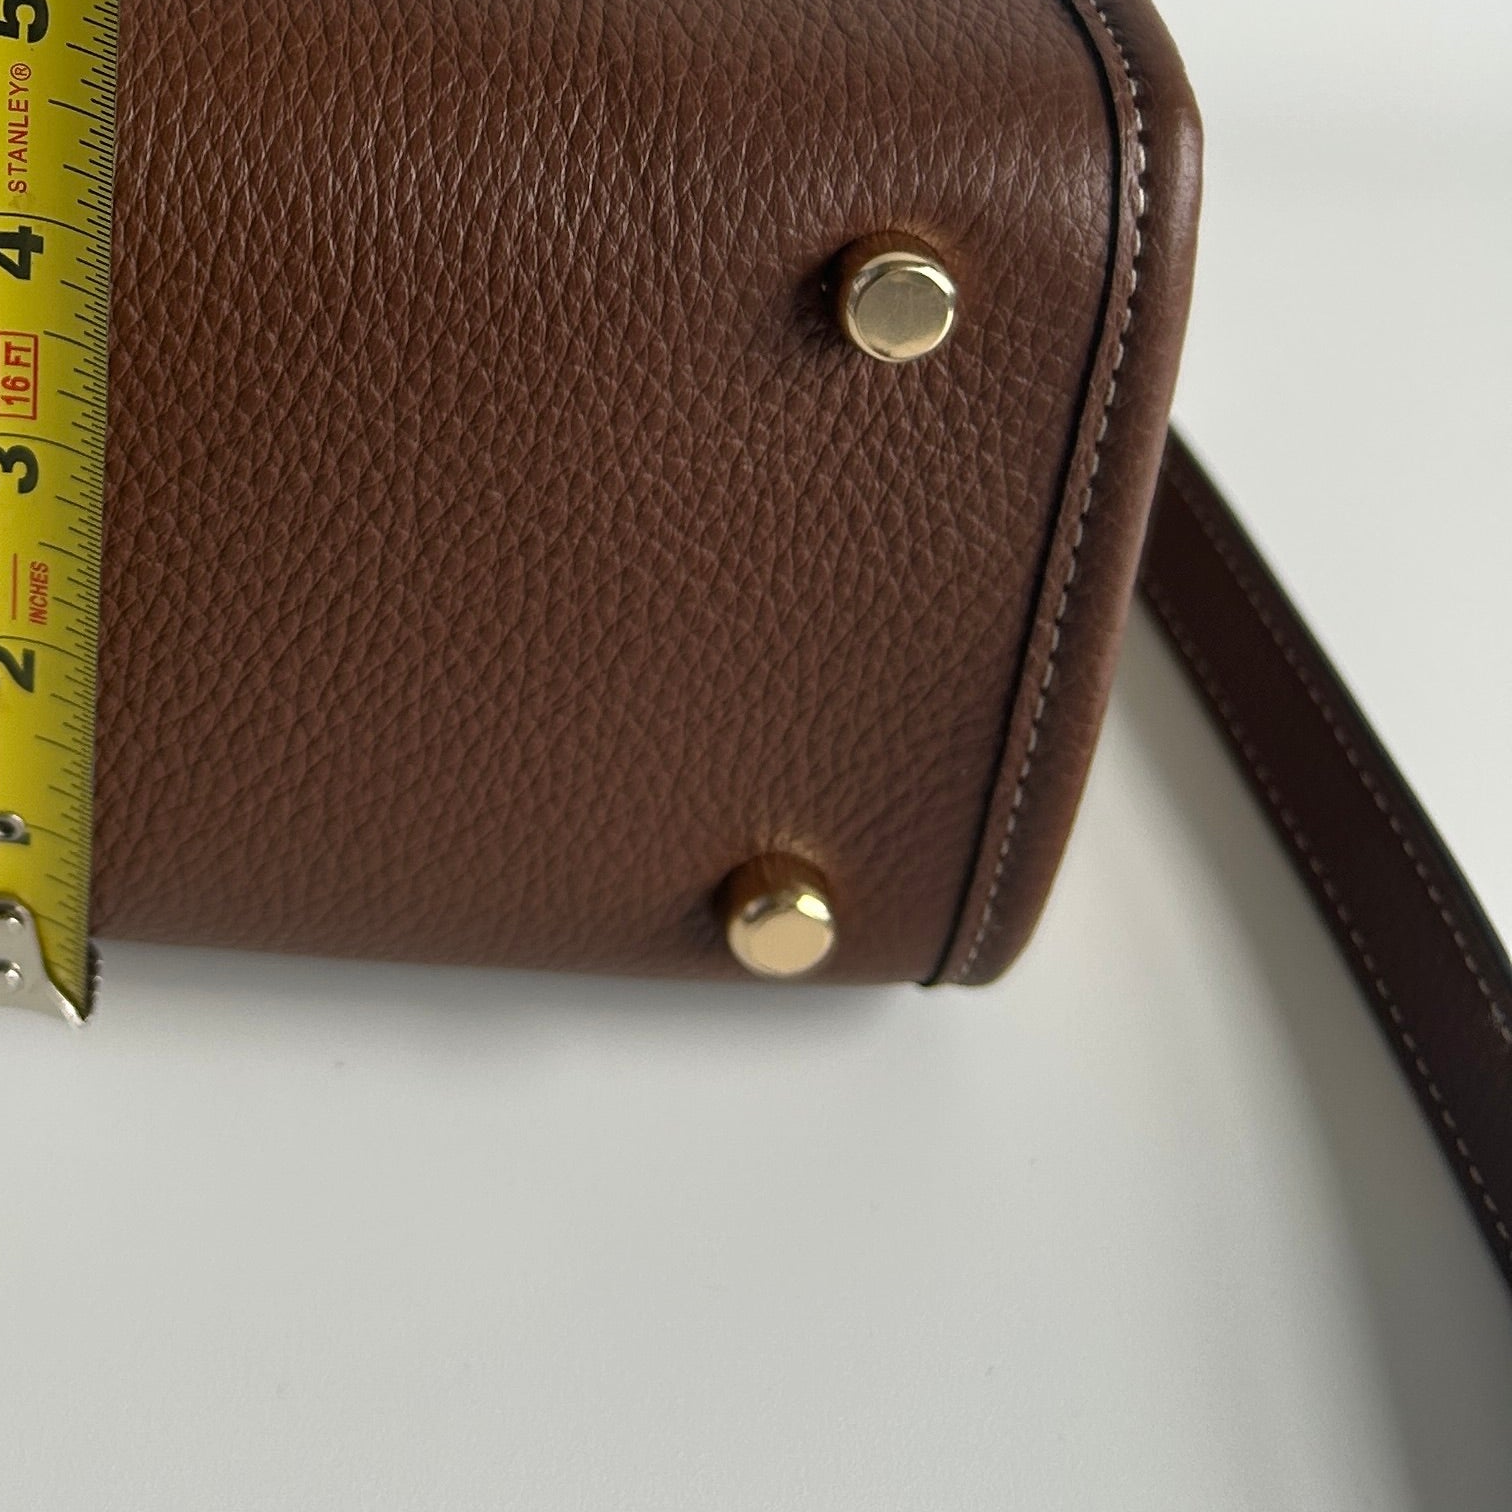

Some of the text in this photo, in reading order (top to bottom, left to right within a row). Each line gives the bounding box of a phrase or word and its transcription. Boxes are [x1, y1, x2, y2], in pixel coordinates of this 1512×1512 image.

[0, 341, 31, 405] 16 FT
[29, 560, 49, 625] INCHES
